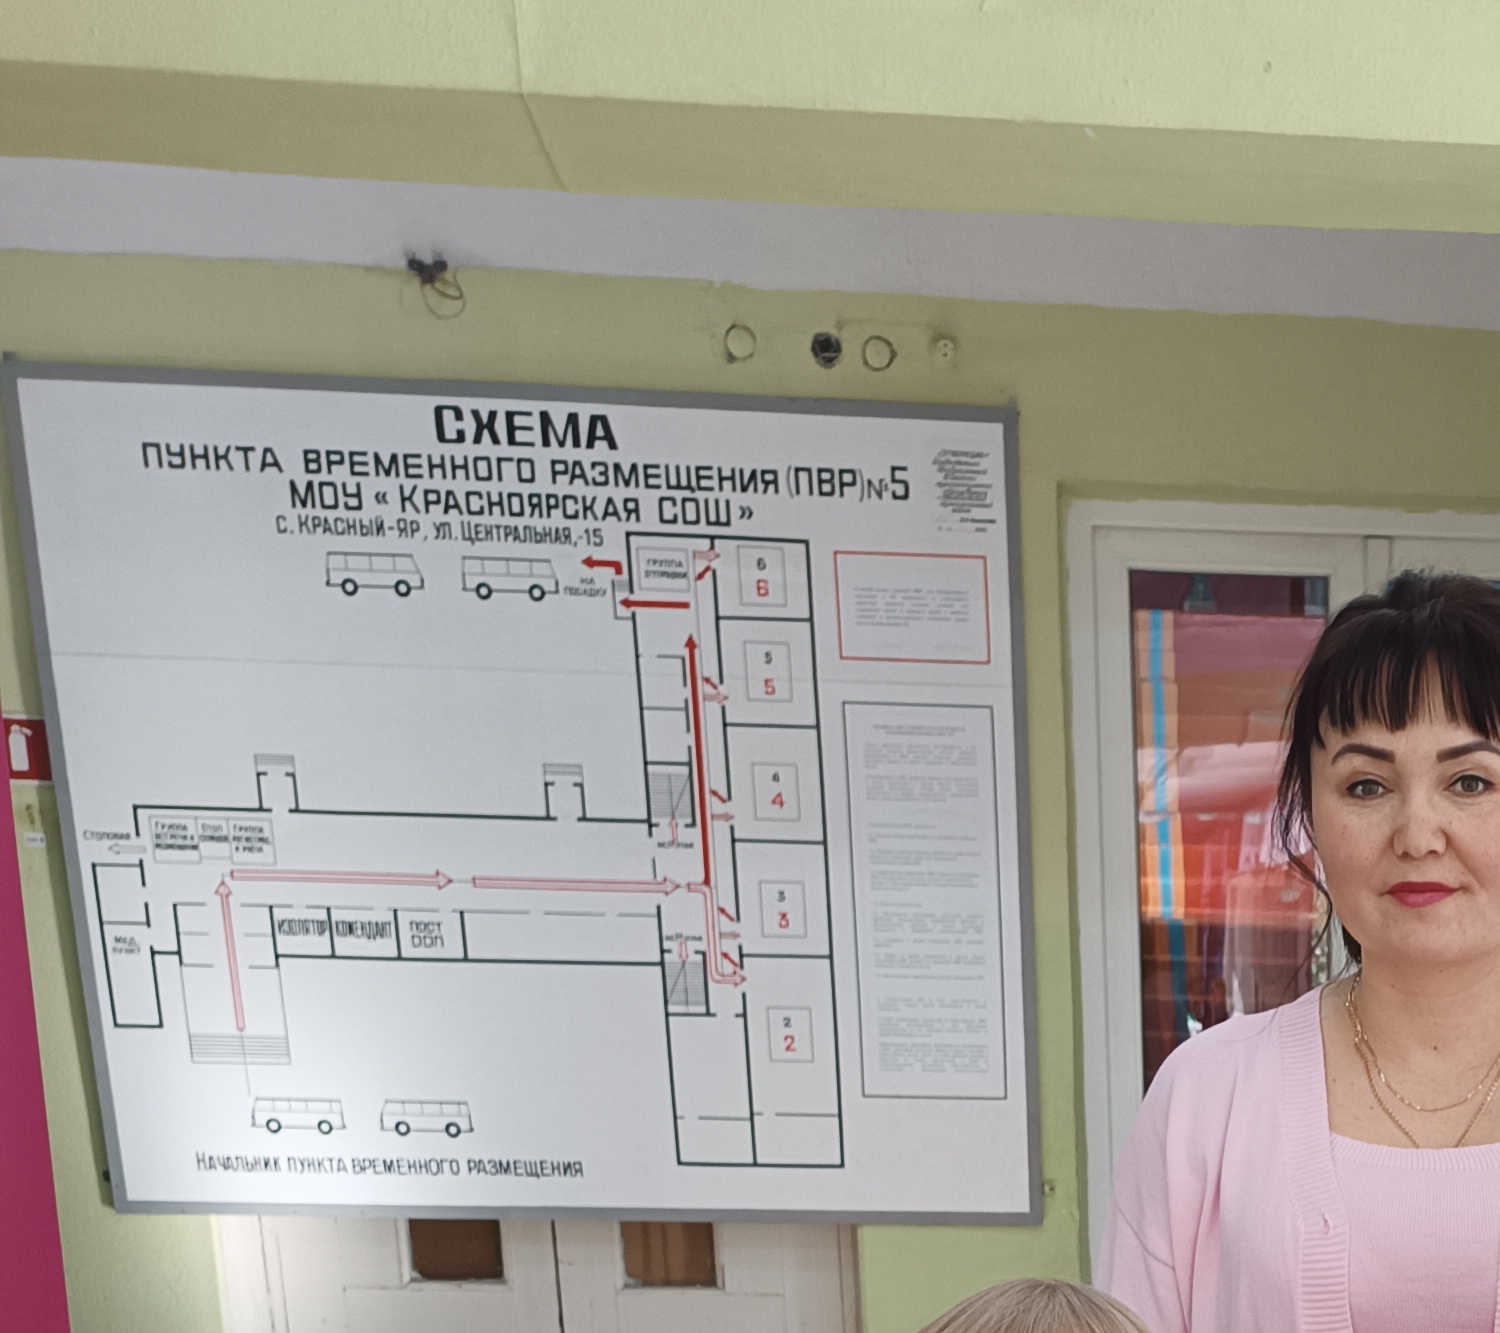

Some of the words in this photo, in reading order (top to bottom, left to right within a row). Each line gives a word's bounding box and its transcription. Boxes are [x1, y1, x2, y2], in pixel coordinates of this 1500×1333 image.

[434, 404, 619, 451] СХЕМА
[140, 441, 284, 475] ПУНКТА
[302, 448, 537, 484] ВРЕМЕННОГО
[550, 458, 780, 495] РАЗМЕЩЕНИЯ
[289, 479, 363, 511] МОУ
[757, 557, 767, 571] 6
[764, 650, 773, 665] 5
[763, 677, 776, 696] 5
[770, 791, 786, 810] 4
[276, 917, 328, 938] ИЗОЛЯТОР
[335, 919, 393, 941] КОМЕНДАНТ
[409, 919, 443, 934] ПОСТ
[782, 1016, 793, 1029] 2
[783, 1034, 797, 1053] 2
[287, 1154, 349, 1175] ПУНКТА
[351, 1155, 461, 1178] ВРЕМЕННОГО
[467, 1157, 585, 1180] РАЗМЕЩЕНИЯ
